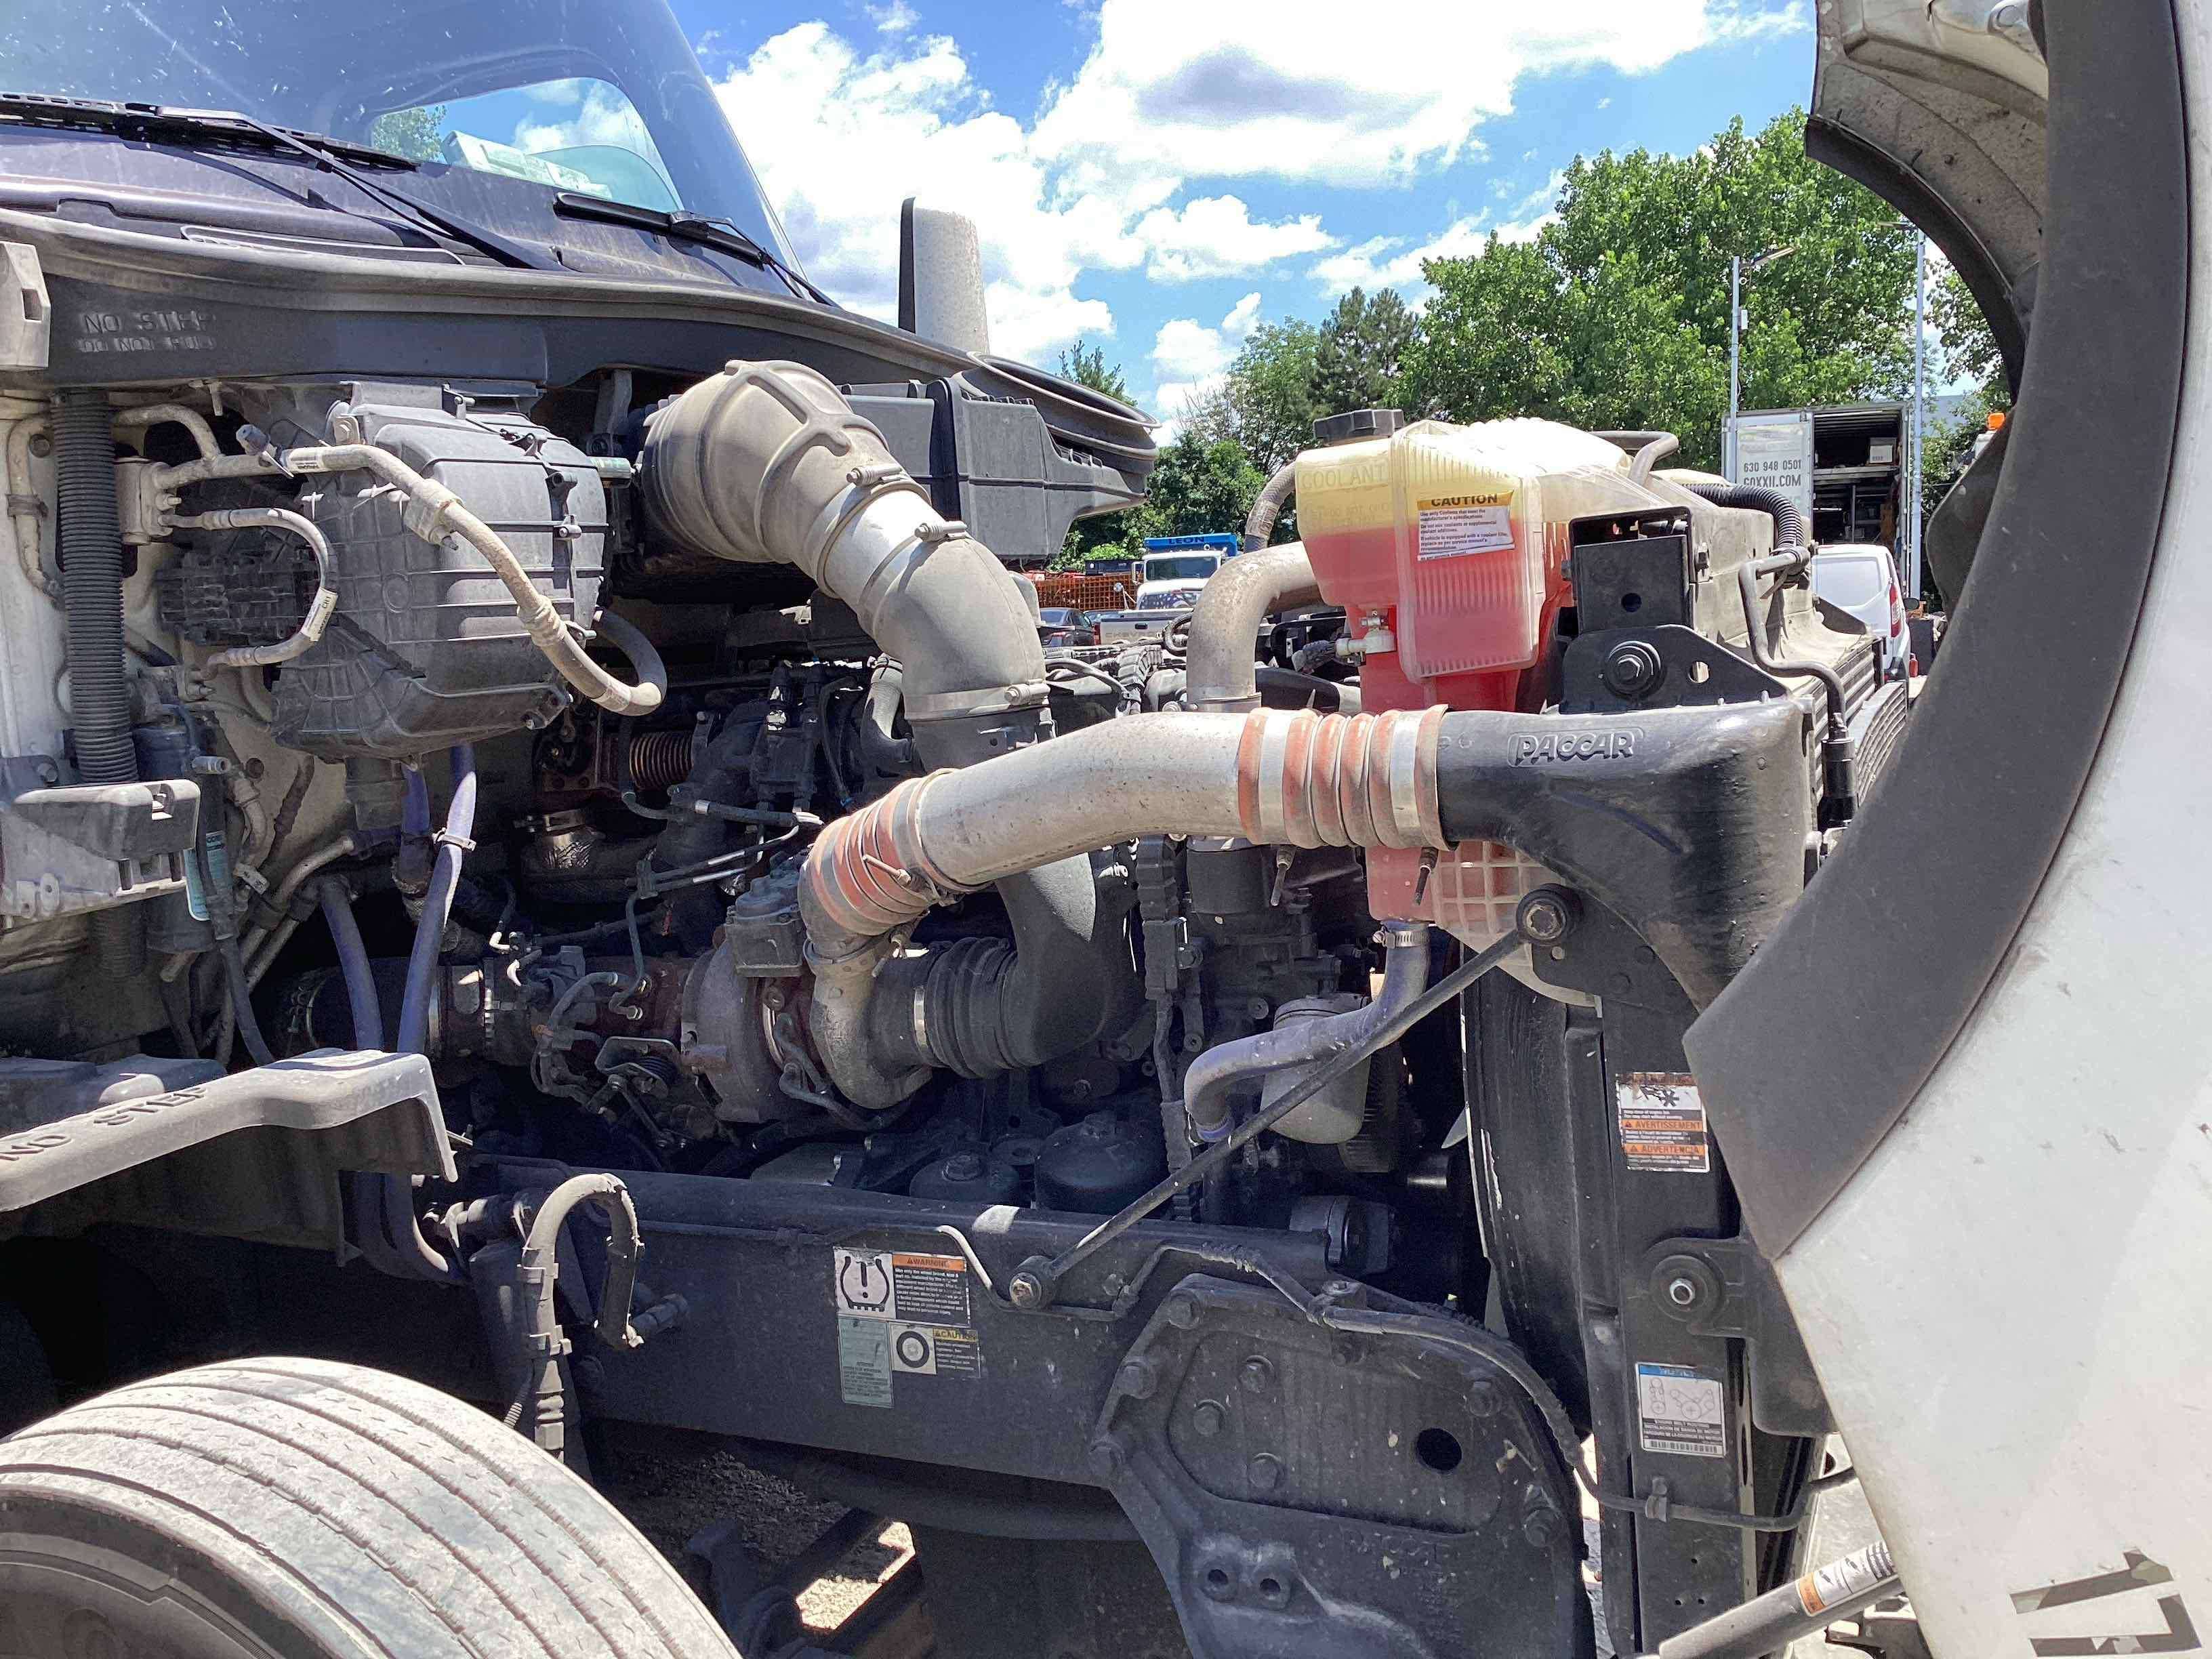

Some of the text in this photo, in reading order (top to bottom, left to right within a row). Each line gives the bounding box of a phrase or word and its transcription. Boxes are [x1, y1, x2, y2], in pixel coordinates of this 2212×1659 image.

[83, 313, 121, 334] NO
[1744, 459, 1801, 472] 630 948 0501
[1302, 464, 1385, 489] COOLANT
[1431, 494, 1498, 507] CAUTION
[1168, 536, 1205, 545] LEON
[1515, 732, 1635, 766] PACCAR
[93, 1086, 207, 1126] STEP
[1635, 1121, 1701, 1129] AVERTISSEMENT
[1641, 1145, 1700, 1153] ADVERTENCIA
